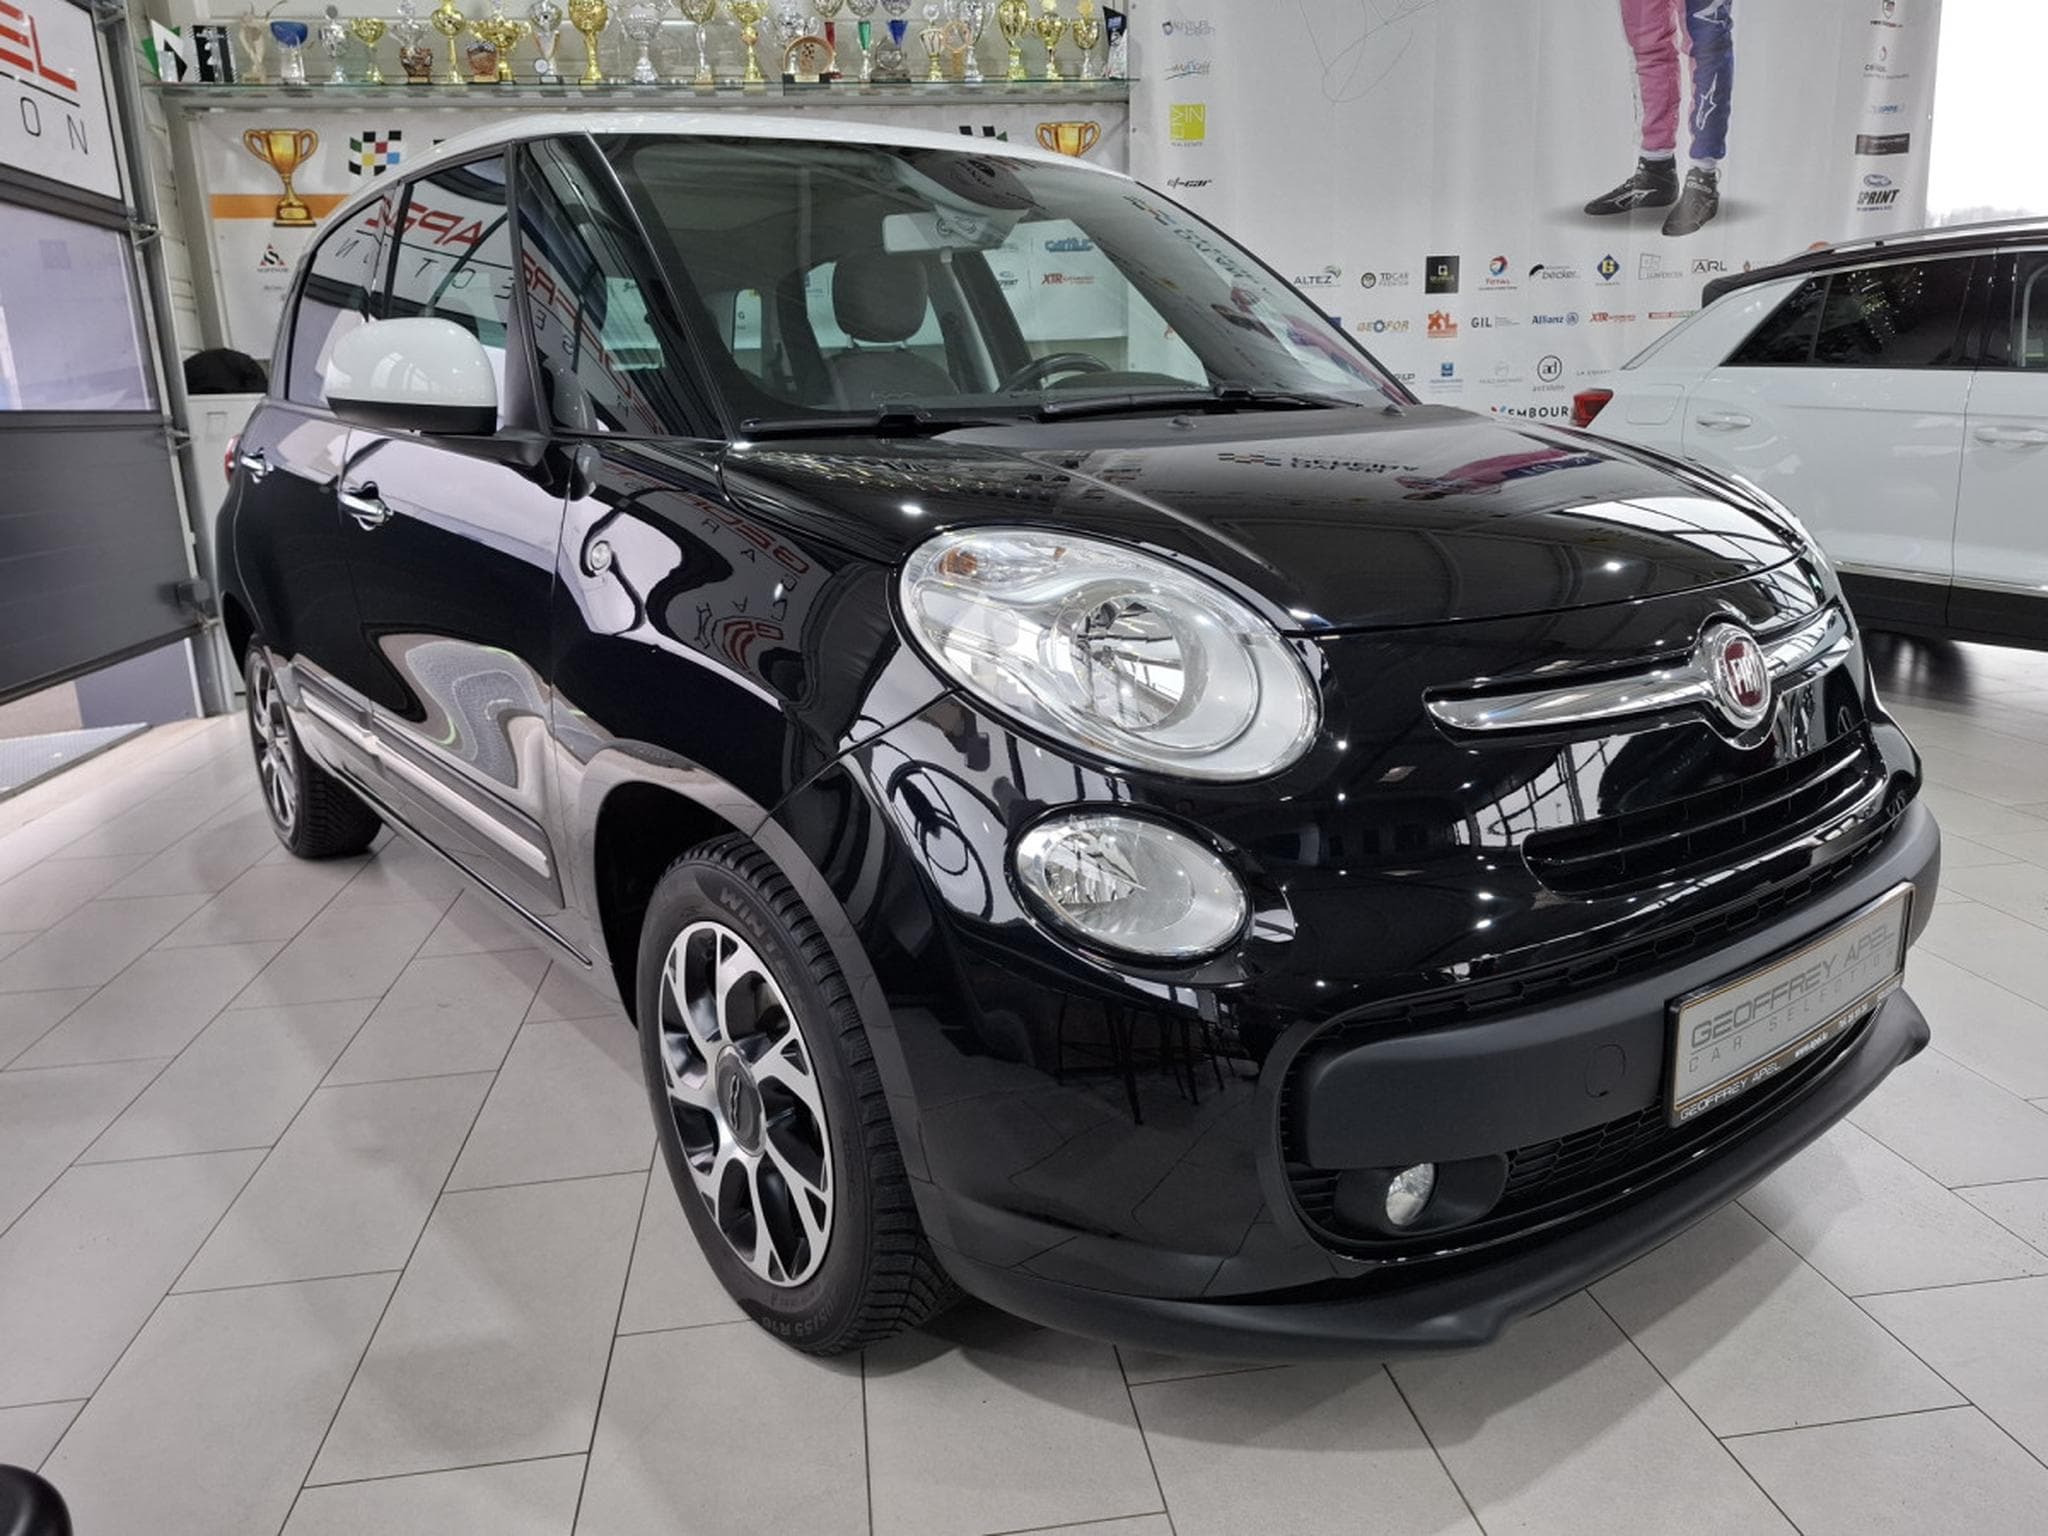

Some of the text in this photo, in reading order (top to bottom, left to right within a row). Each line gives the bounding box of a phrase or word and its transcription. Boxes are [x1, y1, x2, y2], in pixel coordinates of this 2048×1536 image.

[1294, 275, 1332, 285] ALTEZ
[1471, 316, 1493, 329] GIL
[1532, 315, 1565, 325] Allianz
[1691, 923, 1896, 1050] GEOFFREY APEL
[1688, 1036, 1743, 1073] CAR
[1680, 1062, 1783, 1121] GEOFFREY APEL
